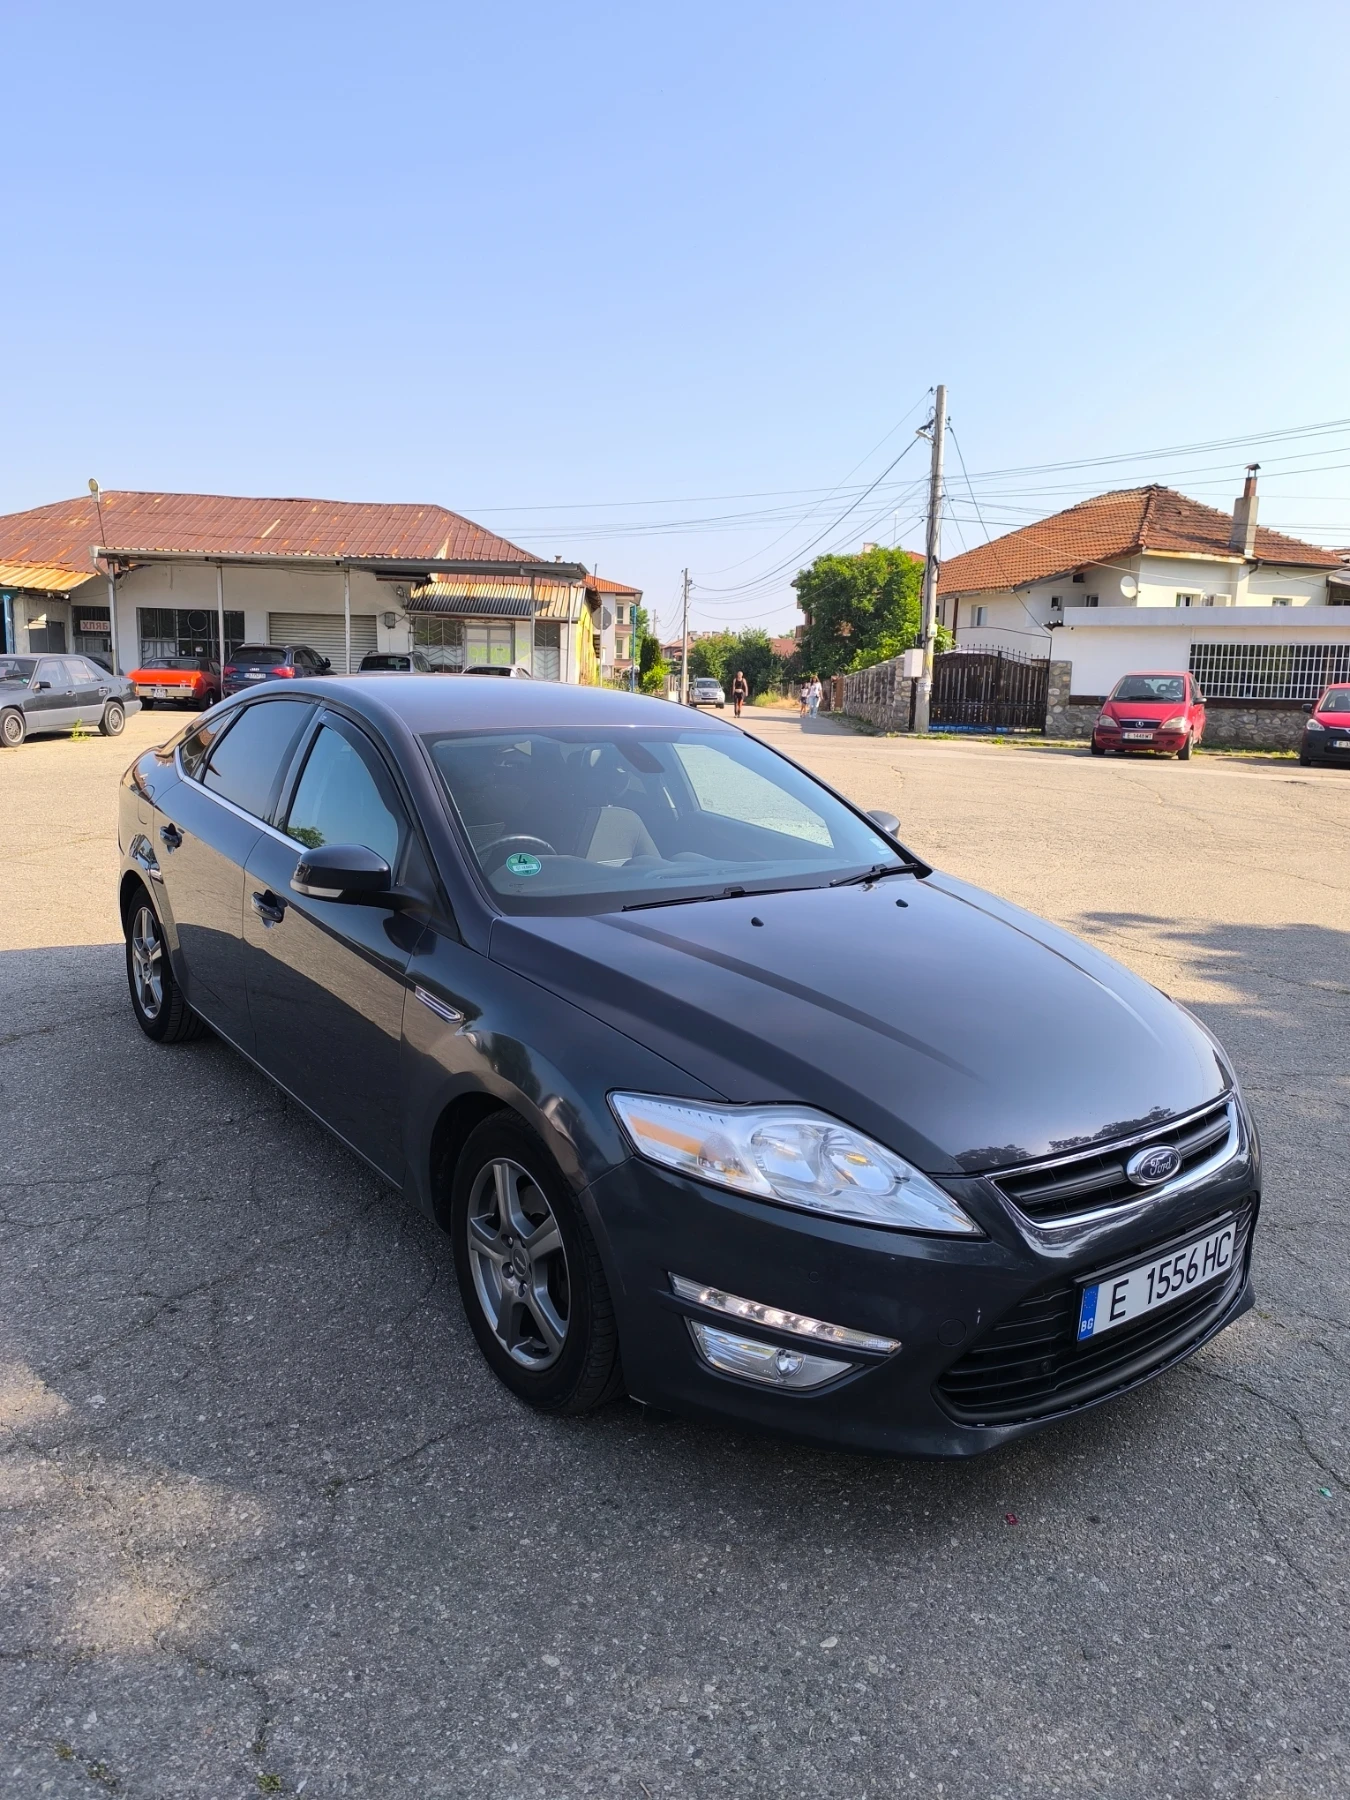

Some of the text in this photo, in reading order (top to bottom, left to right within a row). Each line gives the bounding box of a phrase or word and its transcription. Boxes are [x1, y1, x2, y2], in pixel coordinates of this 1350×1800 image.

[82, 621, 108, 630] ХЛЯБ
[518, 854, 528, 864] 4
[1150, 1156, 1173, 1176] Ford
[1109, 1231, 1232, 1322] E 1556 HC
[1080, 1319, 1094, 1332] BG
